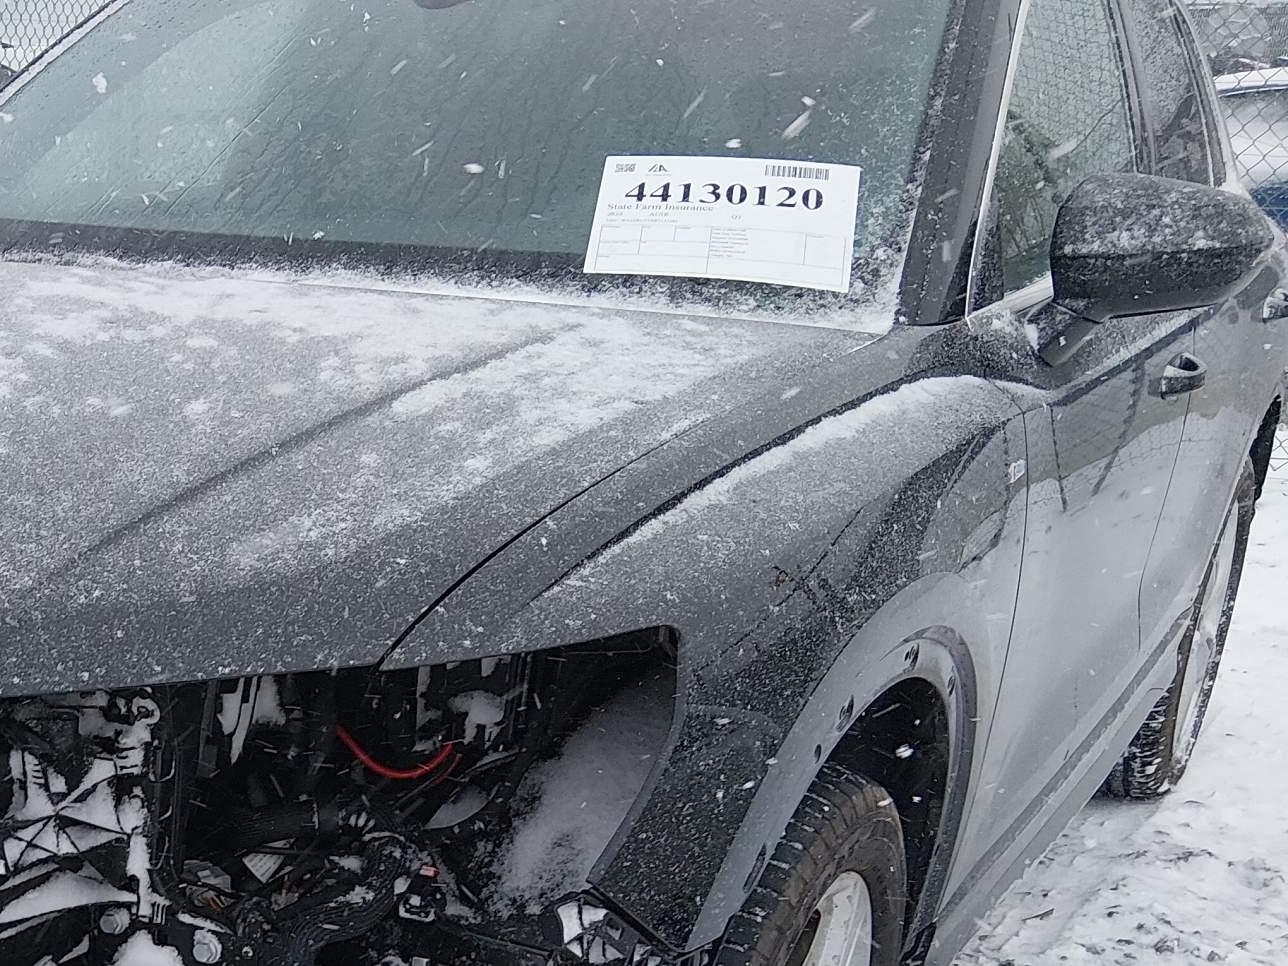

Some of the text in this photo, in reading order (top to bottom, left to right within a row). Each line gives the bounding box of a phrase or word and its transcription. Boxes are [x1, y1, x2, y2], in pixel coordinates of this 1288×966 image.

[624, 182, 824, 210] 44130120
[607, 202, 714, 213] State Farm Insurance
